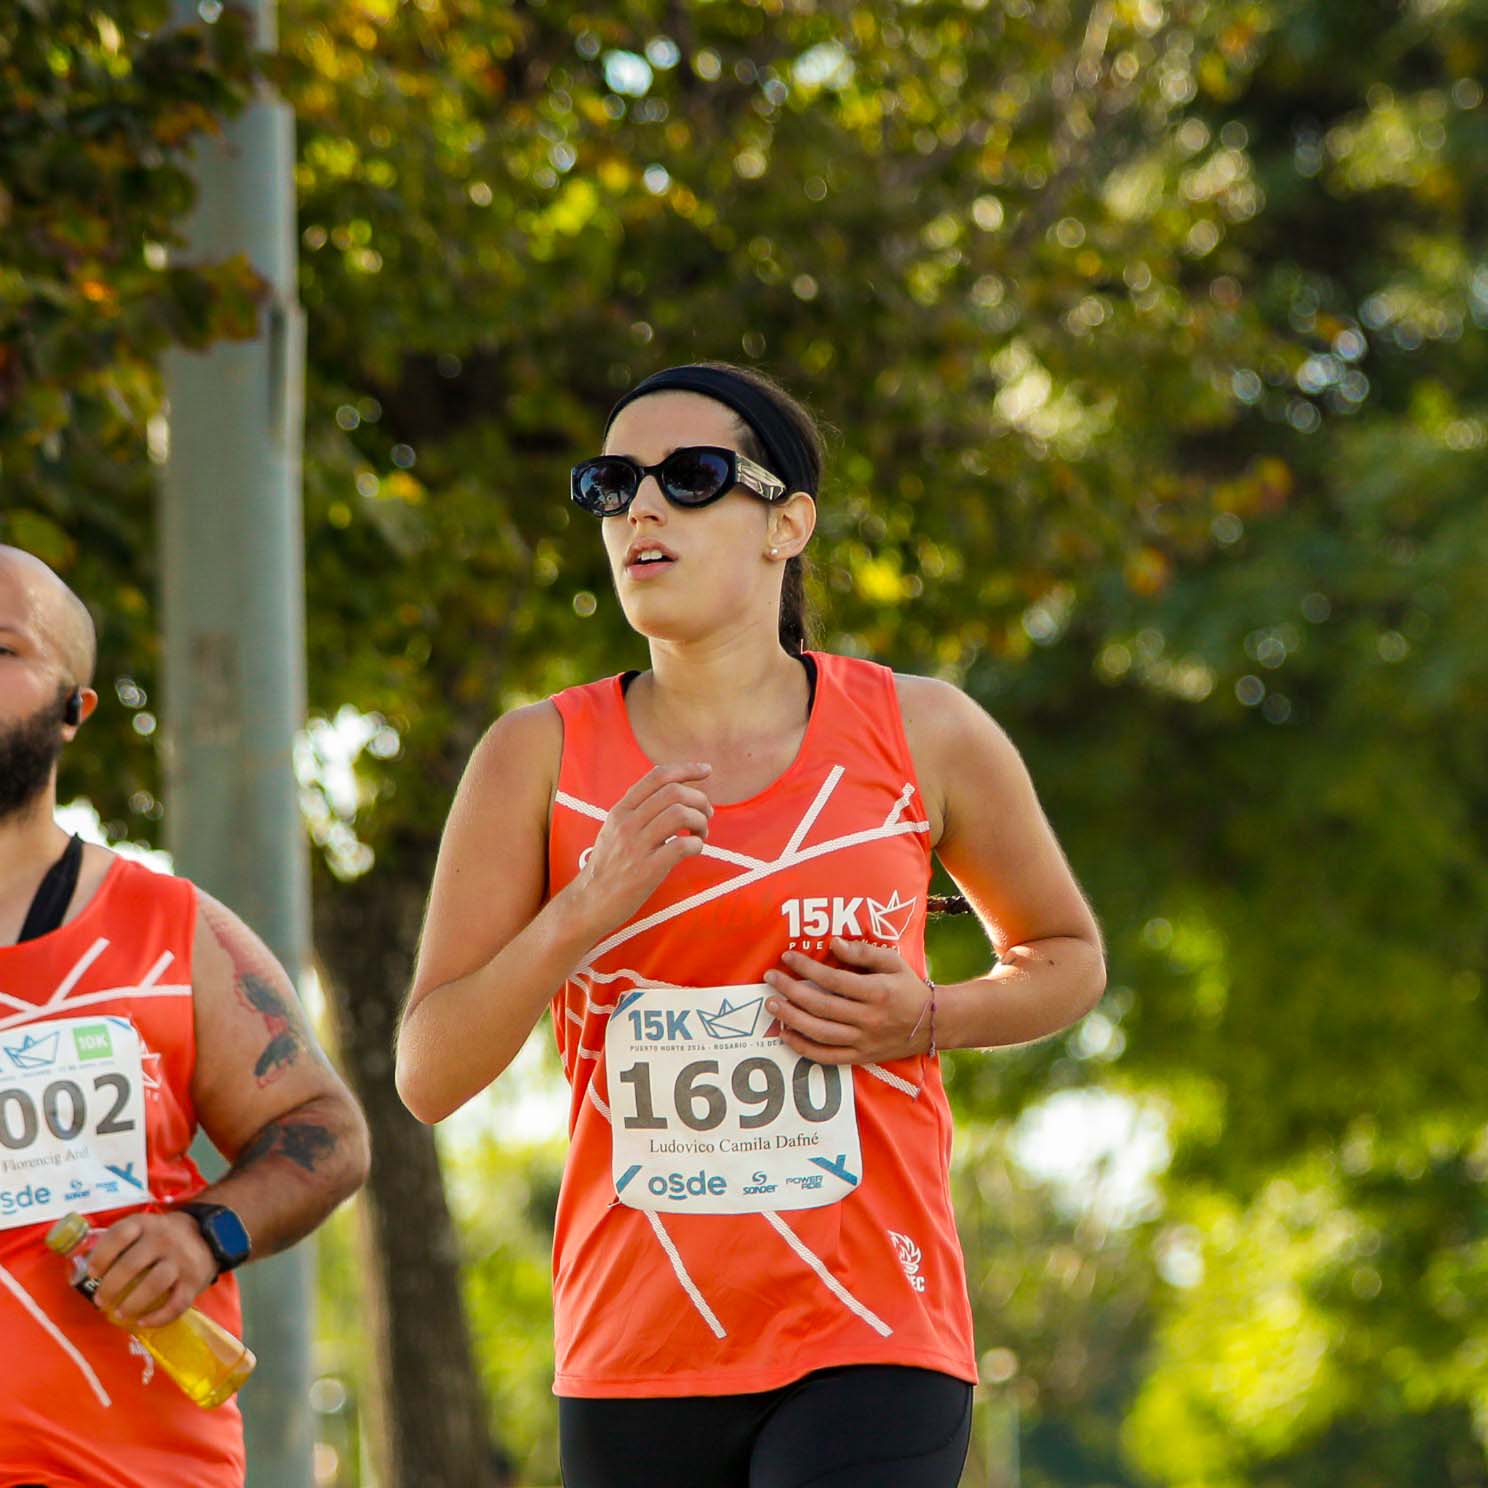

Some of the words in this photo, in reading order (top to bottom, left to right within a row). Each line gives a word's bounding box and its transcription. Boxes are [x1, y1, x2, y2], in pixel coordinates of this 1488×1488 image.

[781, 897, 863, 938] 15K
[627, 1009, 693, 1041] 15K
[630, 1044, 658, 1052] PUERTO
[660, 1044, 684, 1052] NORTE
[713, 1041, 748, 1050] ROSARIO
[620, 1056, 842, 1132] 1690
[650, 1138, 715, 1153] Ludovico
[720, 1136, 771, 1152] Camila
[776, 1131, 819, 1149] Dafné
[648, 1169, 727, 1200] osde
